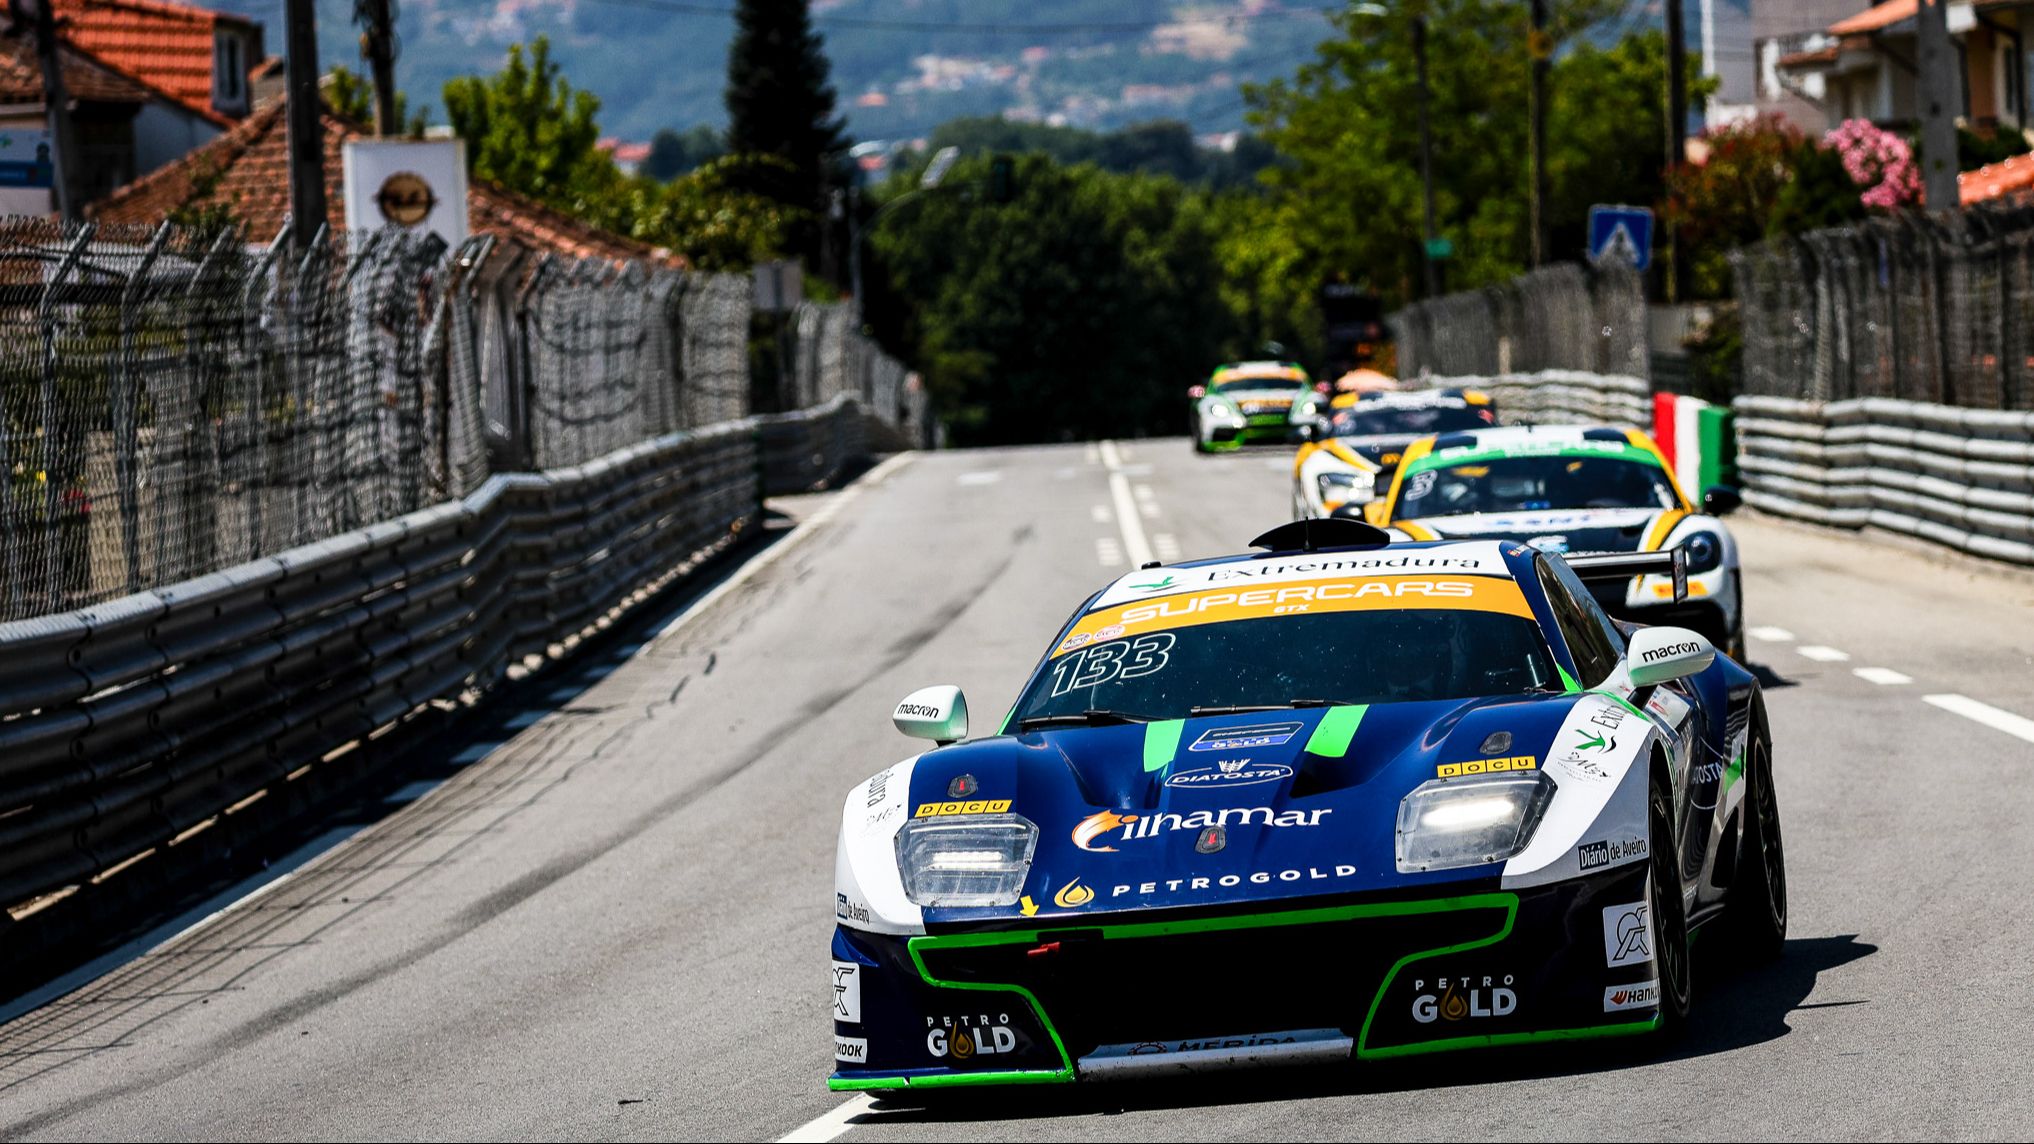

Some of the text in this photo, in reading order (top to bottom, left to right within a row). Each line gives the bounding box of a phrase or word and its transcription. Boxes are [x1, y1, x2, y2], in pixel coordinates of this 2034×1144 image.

[1207, 556, 1480, 582] Extremadura
[1119, 581, 1475, 625] SUPERCARS
[1273, 603, 1310, 614] GTX
[1641, 641, 1701, 663] macron
[1051, 633, 1177, 698] 133
[897, 703, 940, 719] macron
[1443, 758, 1529, 776] DOCU
[1171, 769, 1281, 784] DIATOSTA
[921, 801, 1005, 815] DOCU
[1579, 836, 1647, 868] Diário de Aveiro
[1112, 864, 1357, 898] PETROGOLD
[1414, 974, 1515, 991] PETRO
[926, 1013, 1009, 1028] PETRO
